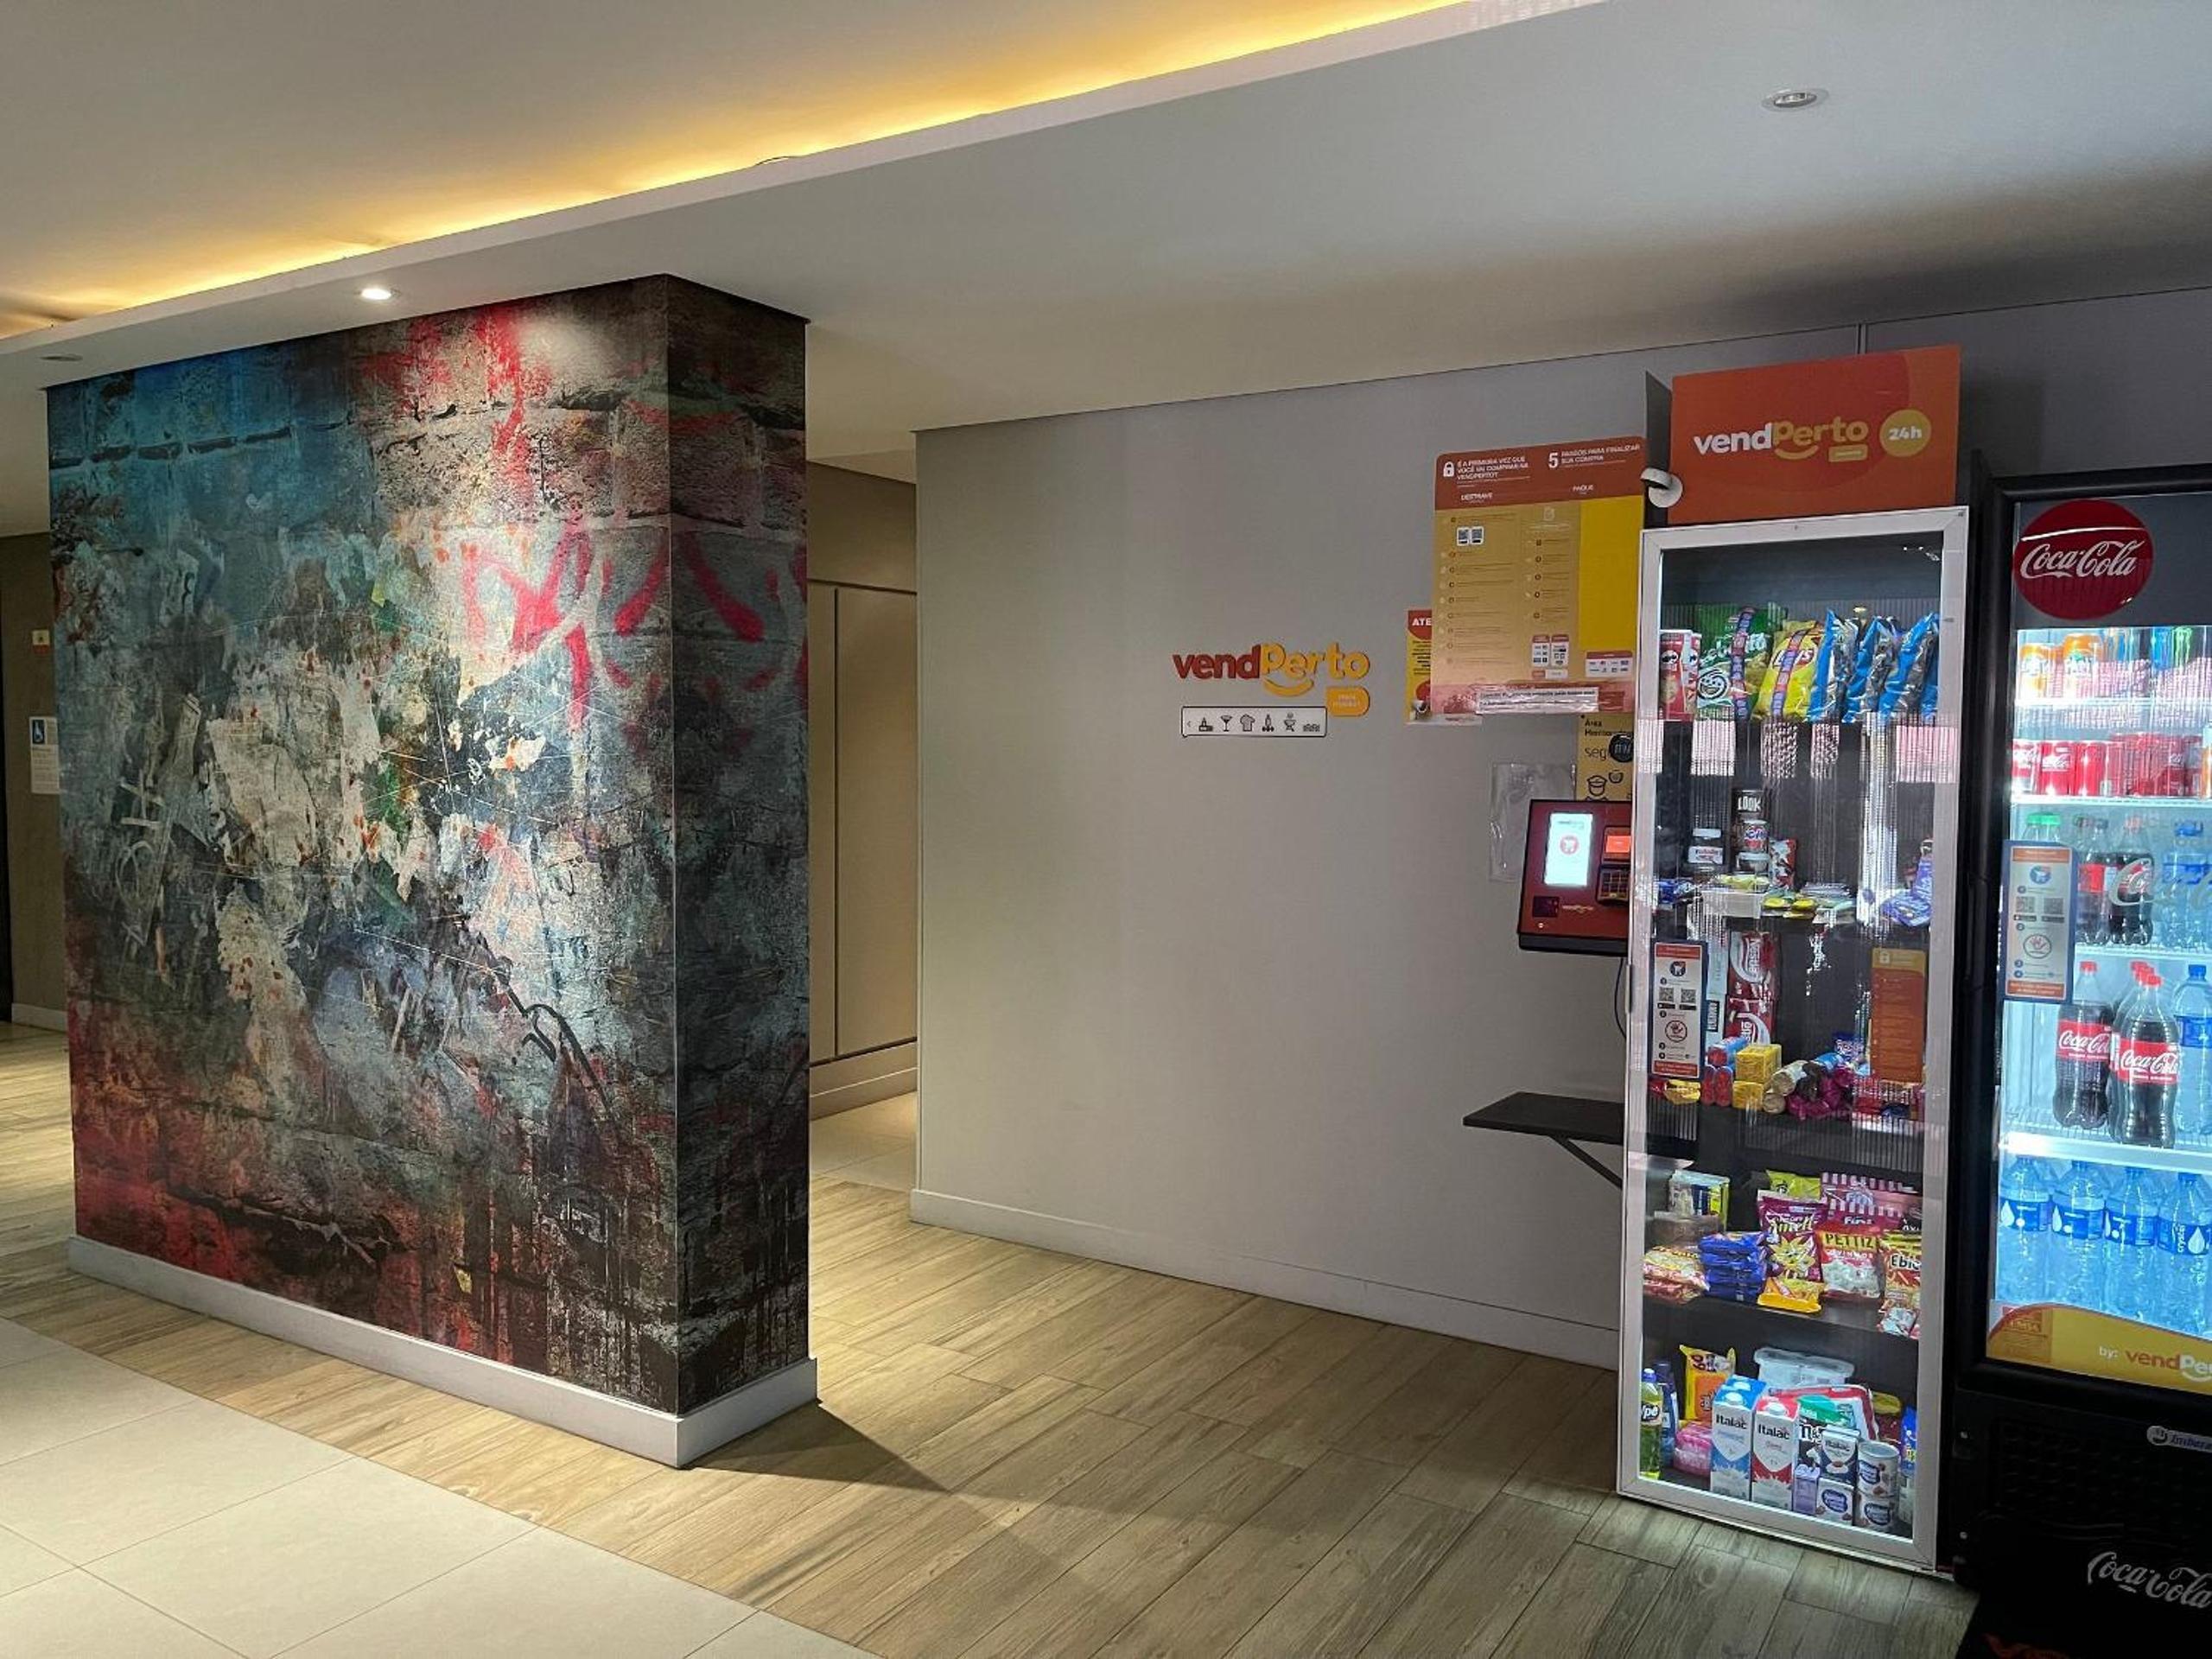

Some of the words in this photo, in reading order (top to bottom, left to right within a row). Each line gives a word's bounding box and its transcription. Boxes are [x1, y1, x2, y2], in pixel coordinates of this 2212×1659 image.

[1694, 416, 1869, 456] vendPerto
[1889, 425, 1923, 442] 24h
[1548, 452, 1559, 468] 5
[2020, 540, 2145, 579] Coca-Cola
[1173, 643, 1370, 681] vendPerto
[2059, 1030, 2109, 1053] Coca-Col
[1825, 1233, 1874, 1249] PETTIZ
[1716, 1414, 1748, 1430] Italac
[1758, 1424, 1791, 1441] Italac
[2088, 1552, 2212, 1609] Coca-Cola
